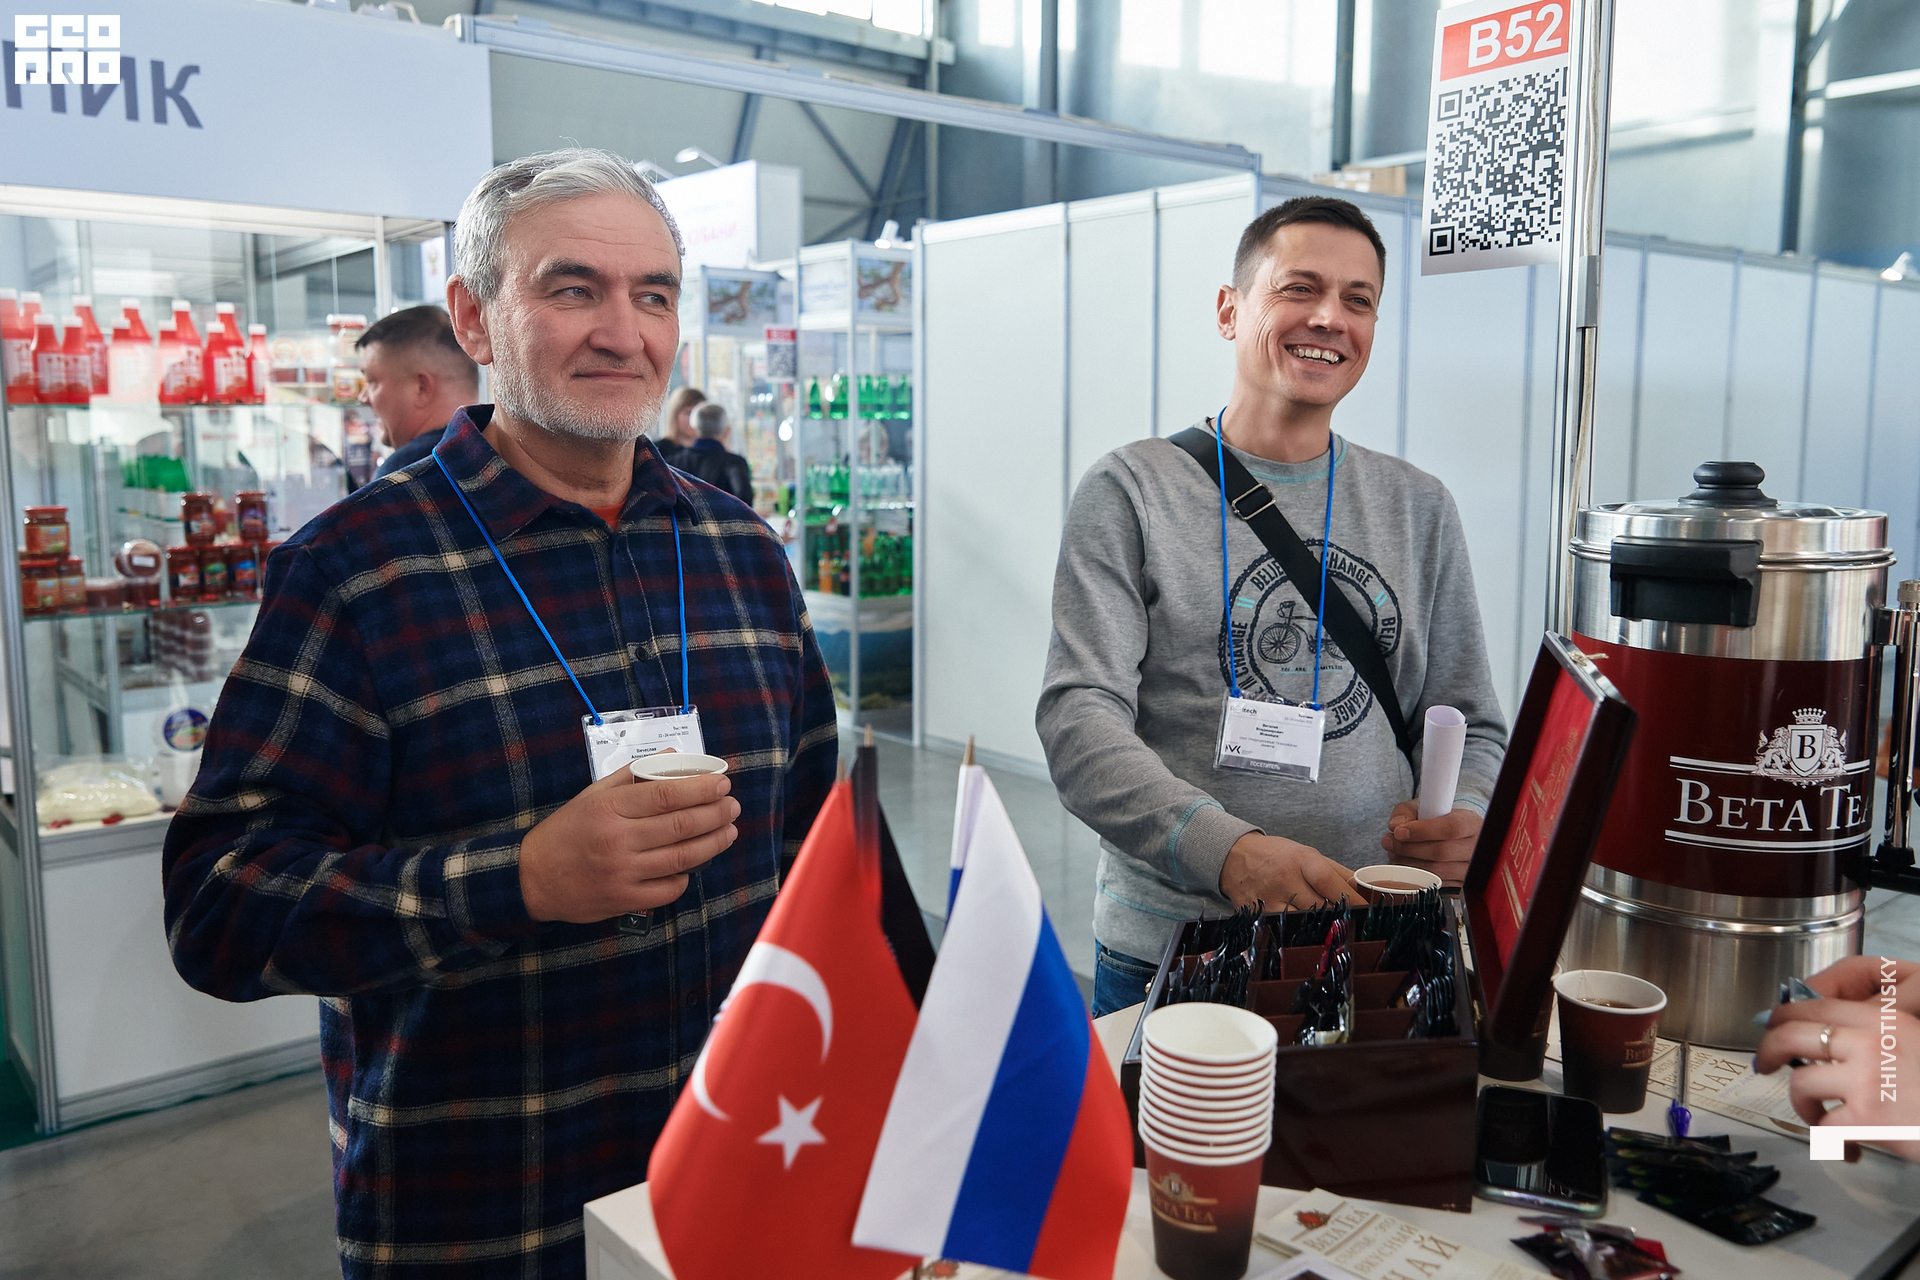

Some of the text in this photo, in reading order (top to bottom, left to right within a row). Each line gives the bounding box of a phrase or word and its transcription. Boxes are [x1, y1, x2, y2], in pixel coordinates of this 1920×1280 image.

[1467, 3, 1563, 69] B52
[1331, 681, 1368, 725] CHANGE
[1249, 760, 1281, 771] ПОСЕТИТЕЛЬ
[1797, 734, 1816, 760] B
[1673, 776, 1814, 832] BETA
[1509, 802, 1535, 893] BETA
[1689, 1058, 1749, 1093] ЧАЙ
[1303, 1208, 1370, 1251] BETA TEA
[1353, 1224, 1419, 1274] ВКУСНЫЙ
